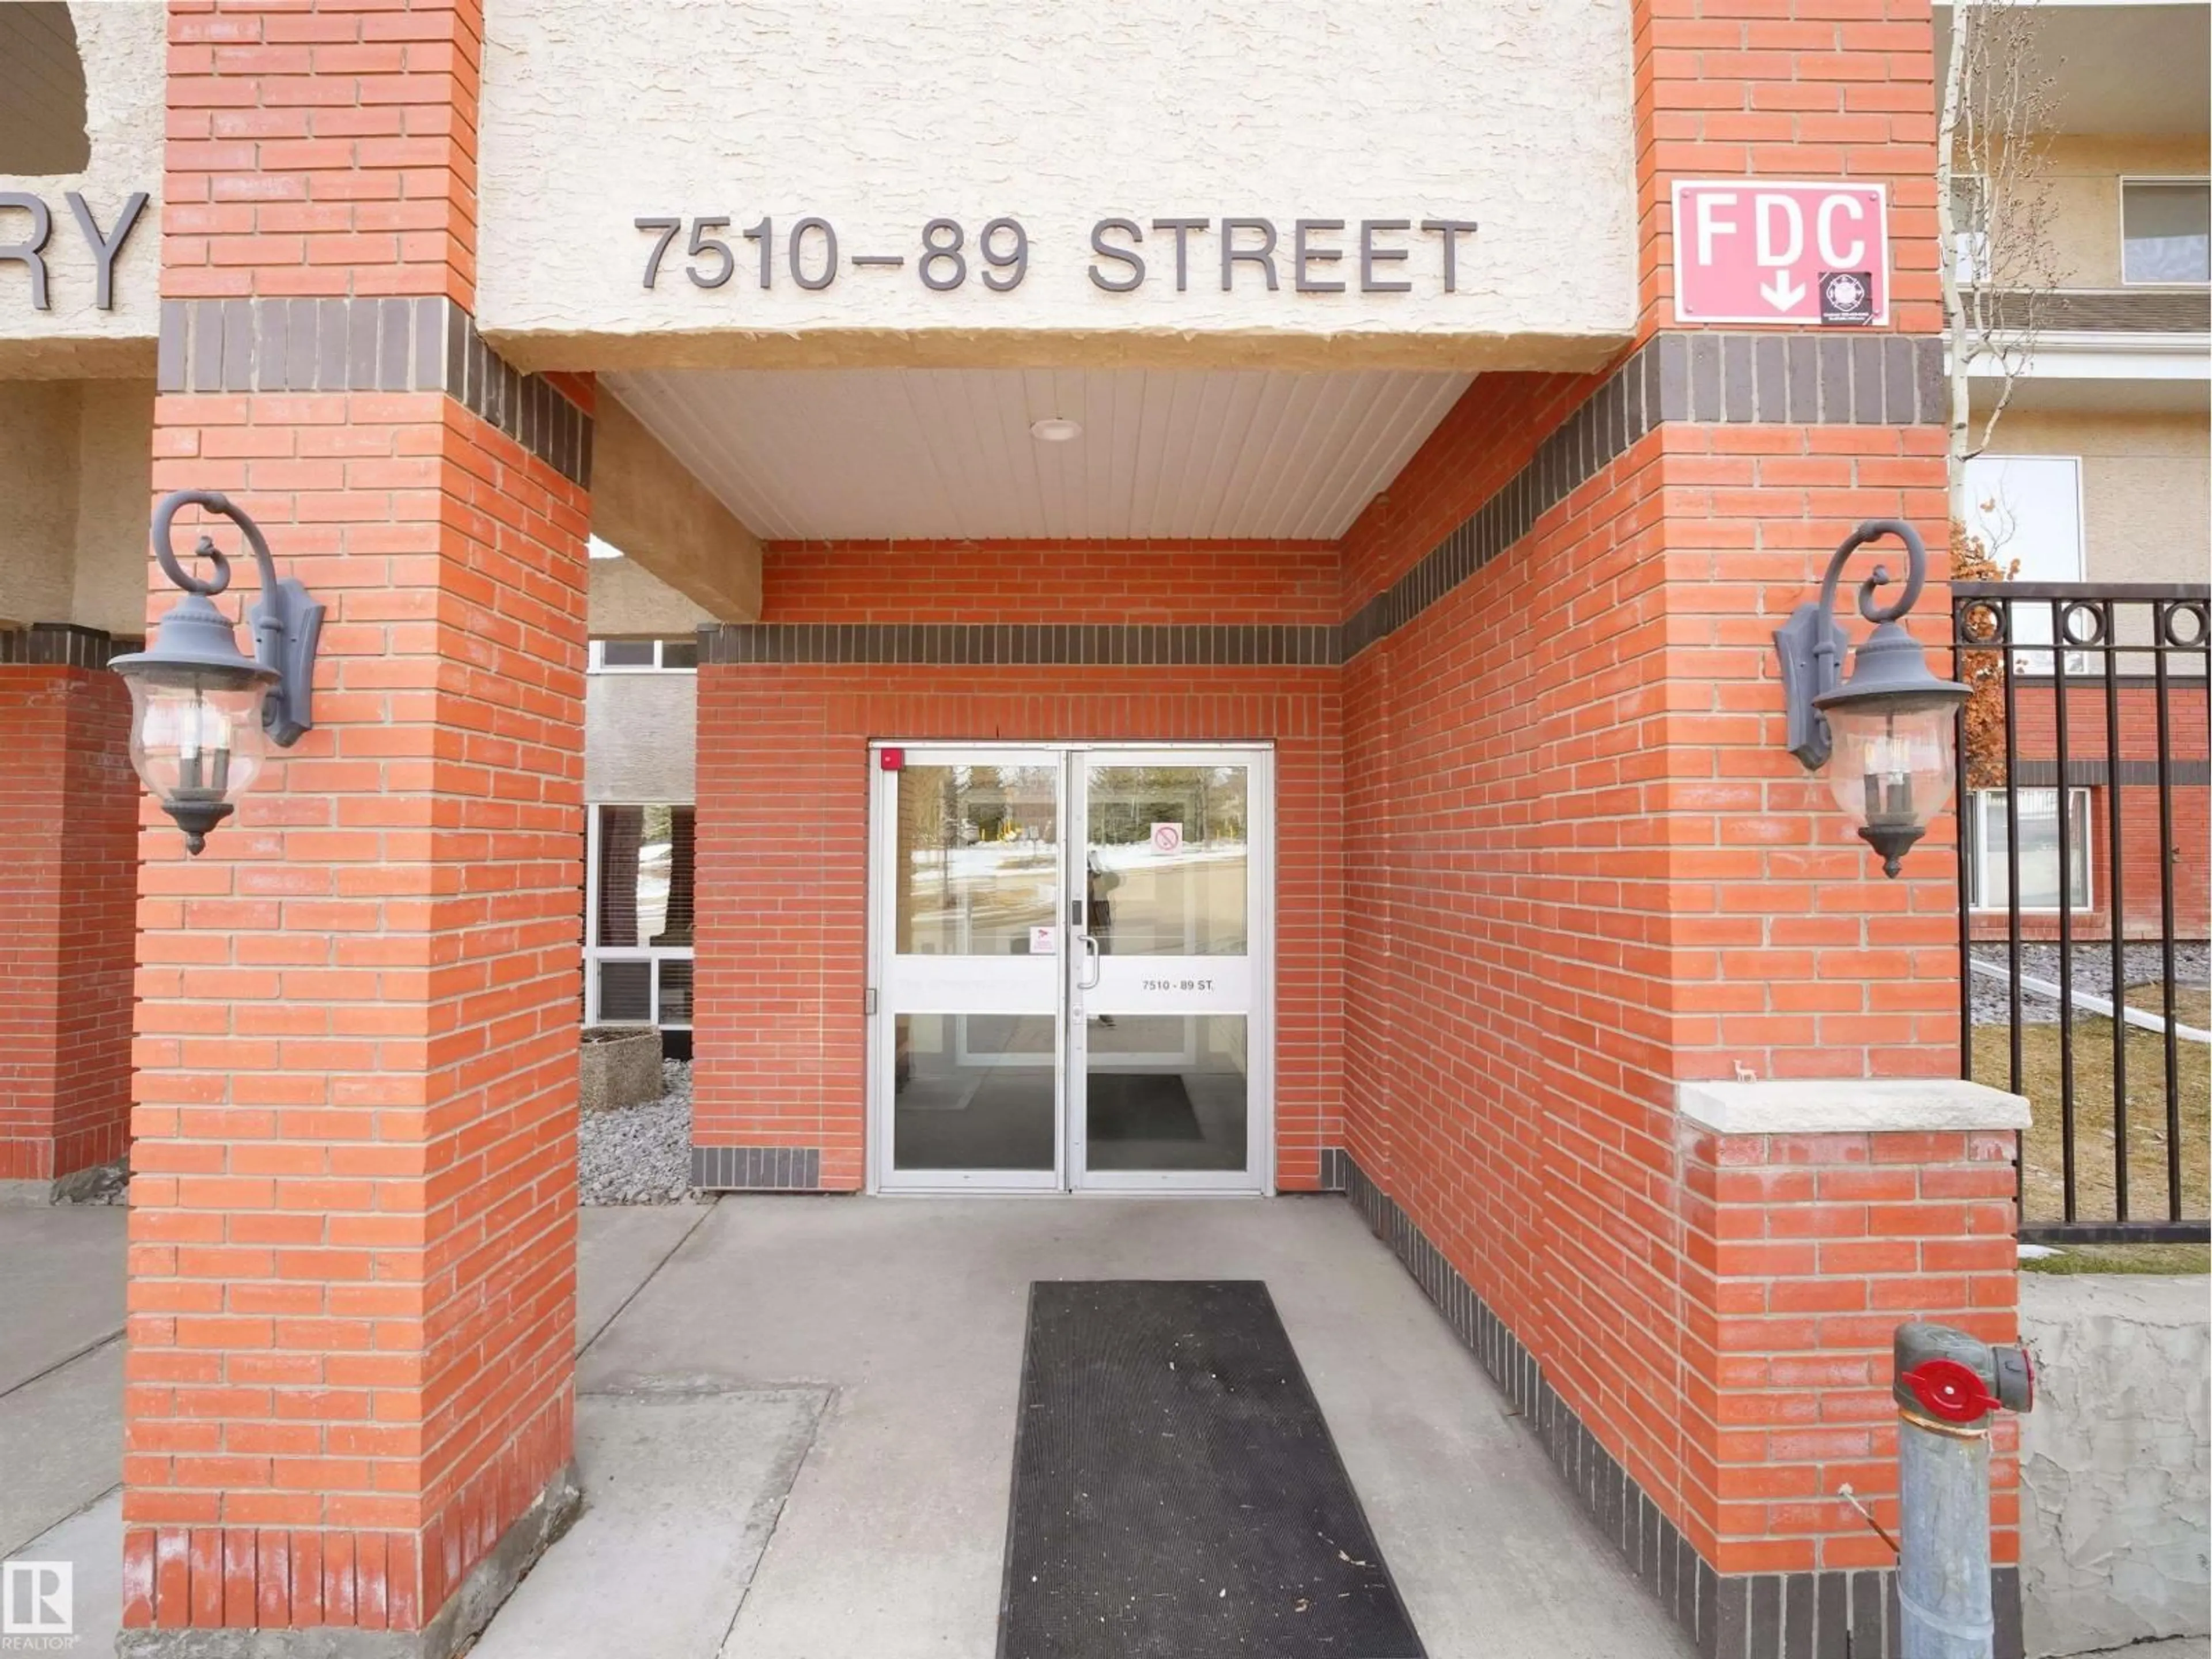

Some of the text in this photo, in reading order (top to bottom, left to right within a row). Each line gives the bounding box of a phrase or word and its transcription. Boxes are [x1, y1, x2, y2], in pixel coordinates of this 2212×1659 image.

[1088, 218, 1478, 293] STREET
[1696, 192, 1866, 270] FDC
[1142, 979, 1170, 991] 7510
[1180, 979, 1194, 991] 89
